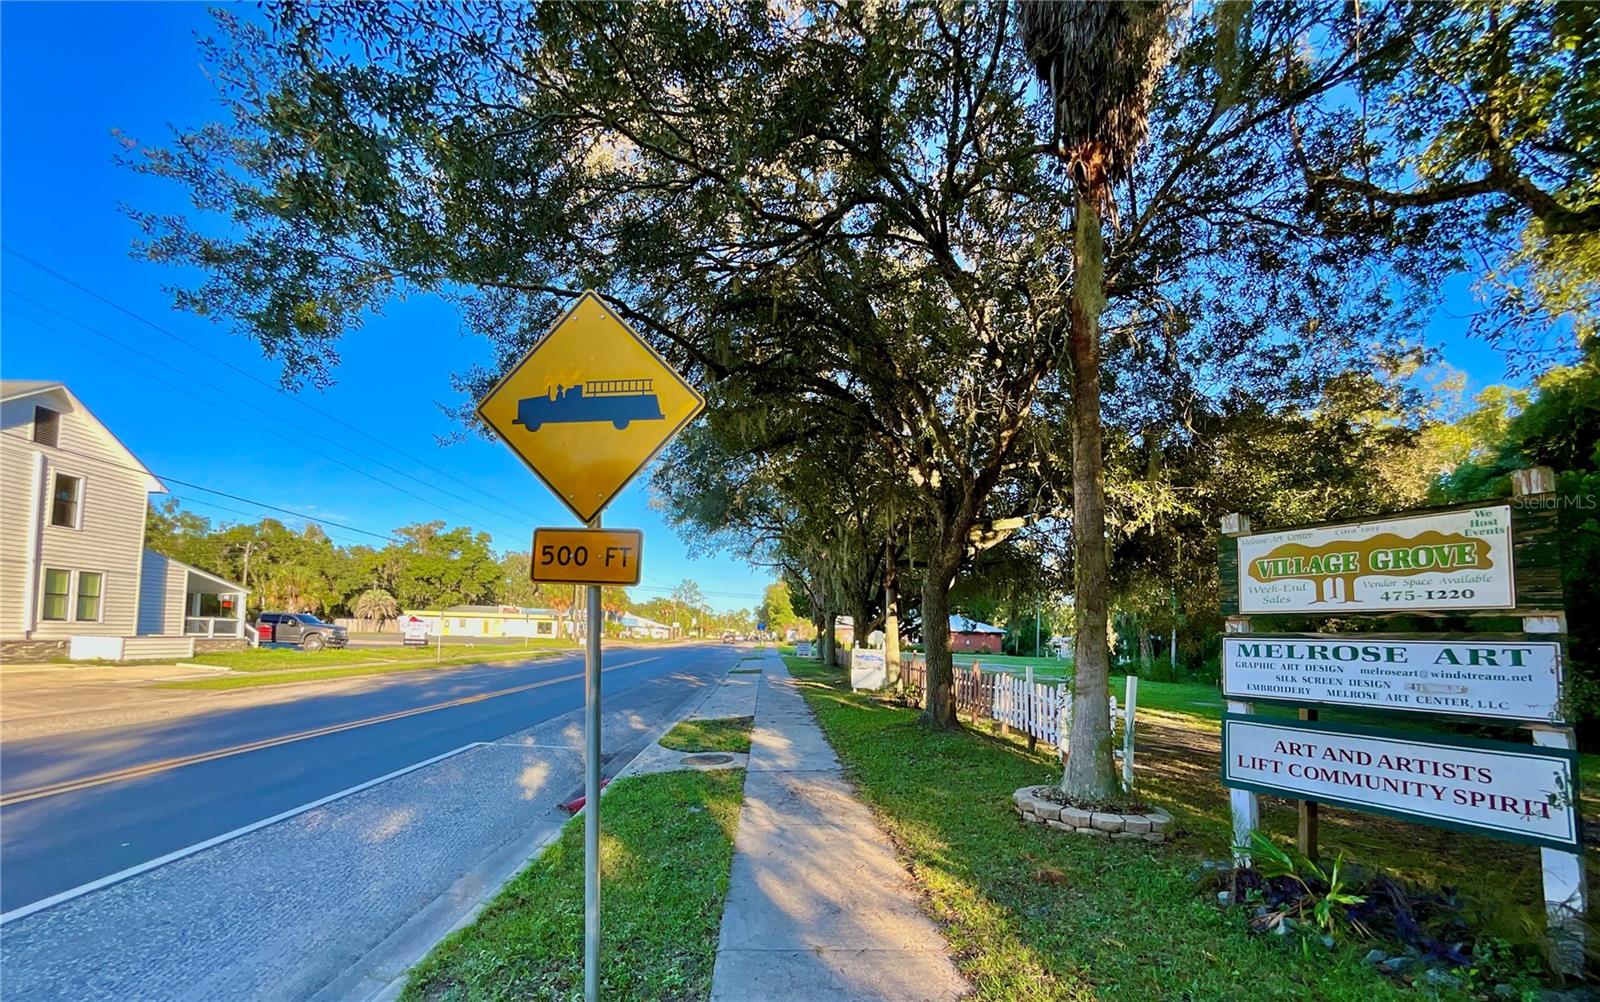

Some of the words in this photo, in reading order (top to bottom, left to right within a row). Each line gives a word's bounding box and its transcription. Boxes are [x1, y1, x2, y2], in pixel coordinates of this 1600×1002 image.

[1474, 510, 1492, 518] We
[1470, 518, 1497, 528] Host
[1271, 535, 1283, 544] Art
[1287, 532, 1314, 542] Center
[1334, 528, 1357, 536] Circa
[1464, 527, 1505, 537] Events
[541, 545, 588, 567] 500
[605, 547, 632, 568] FT
[1256, 552, 1359, 579] VILLAGE
[1369, 542, 1477, 572] GROVE
[1363, 579, 1397, 589] Vendor
[1403, 577, 1432, 589] Space
[1439, 573, 1493, 585] Available
[1248, 583, 1308, 594] Week-End
[1262, 595, 1291, 605] Sales
[1380, 589, 1475, 602] 475-1220
[1236, 643, 1408, 664] MELROSE
[1433, 648, 1532, 667] ART
[1235, 661, 1275, 670] GRAPHIC
[1281, 663, 1300, 671] ART
[1305, 664, 1344, 673] DESIGN
[1360, 667, 1533, 682] melroseart@windstream.net
[1276, 675, 1297, 683] SILK
[1302, 676, 1343, 686] SCREEN
[1348, 679, 1392, 688] DESIGN
[1247, 683, 1311, 695] EMBROIDERY
[1327, 689, 1380, 701] MELROSE
[1385, 693, 1410, 703] ART
[1416, 695, 1474, 709] CENTER,
[1478, 700, 1510, 710] LLC
[1274, 740, 1318, 758] ART
[1322, 747, 1372, 766] AND
[1377, 754, 1492, 784] ARTISTS
[1237, 754, 1283, 774] LIFT
[1288, 763, 1448, 801] COMMUNITY
[1453, 789, 1551, 819] SPIRIT
